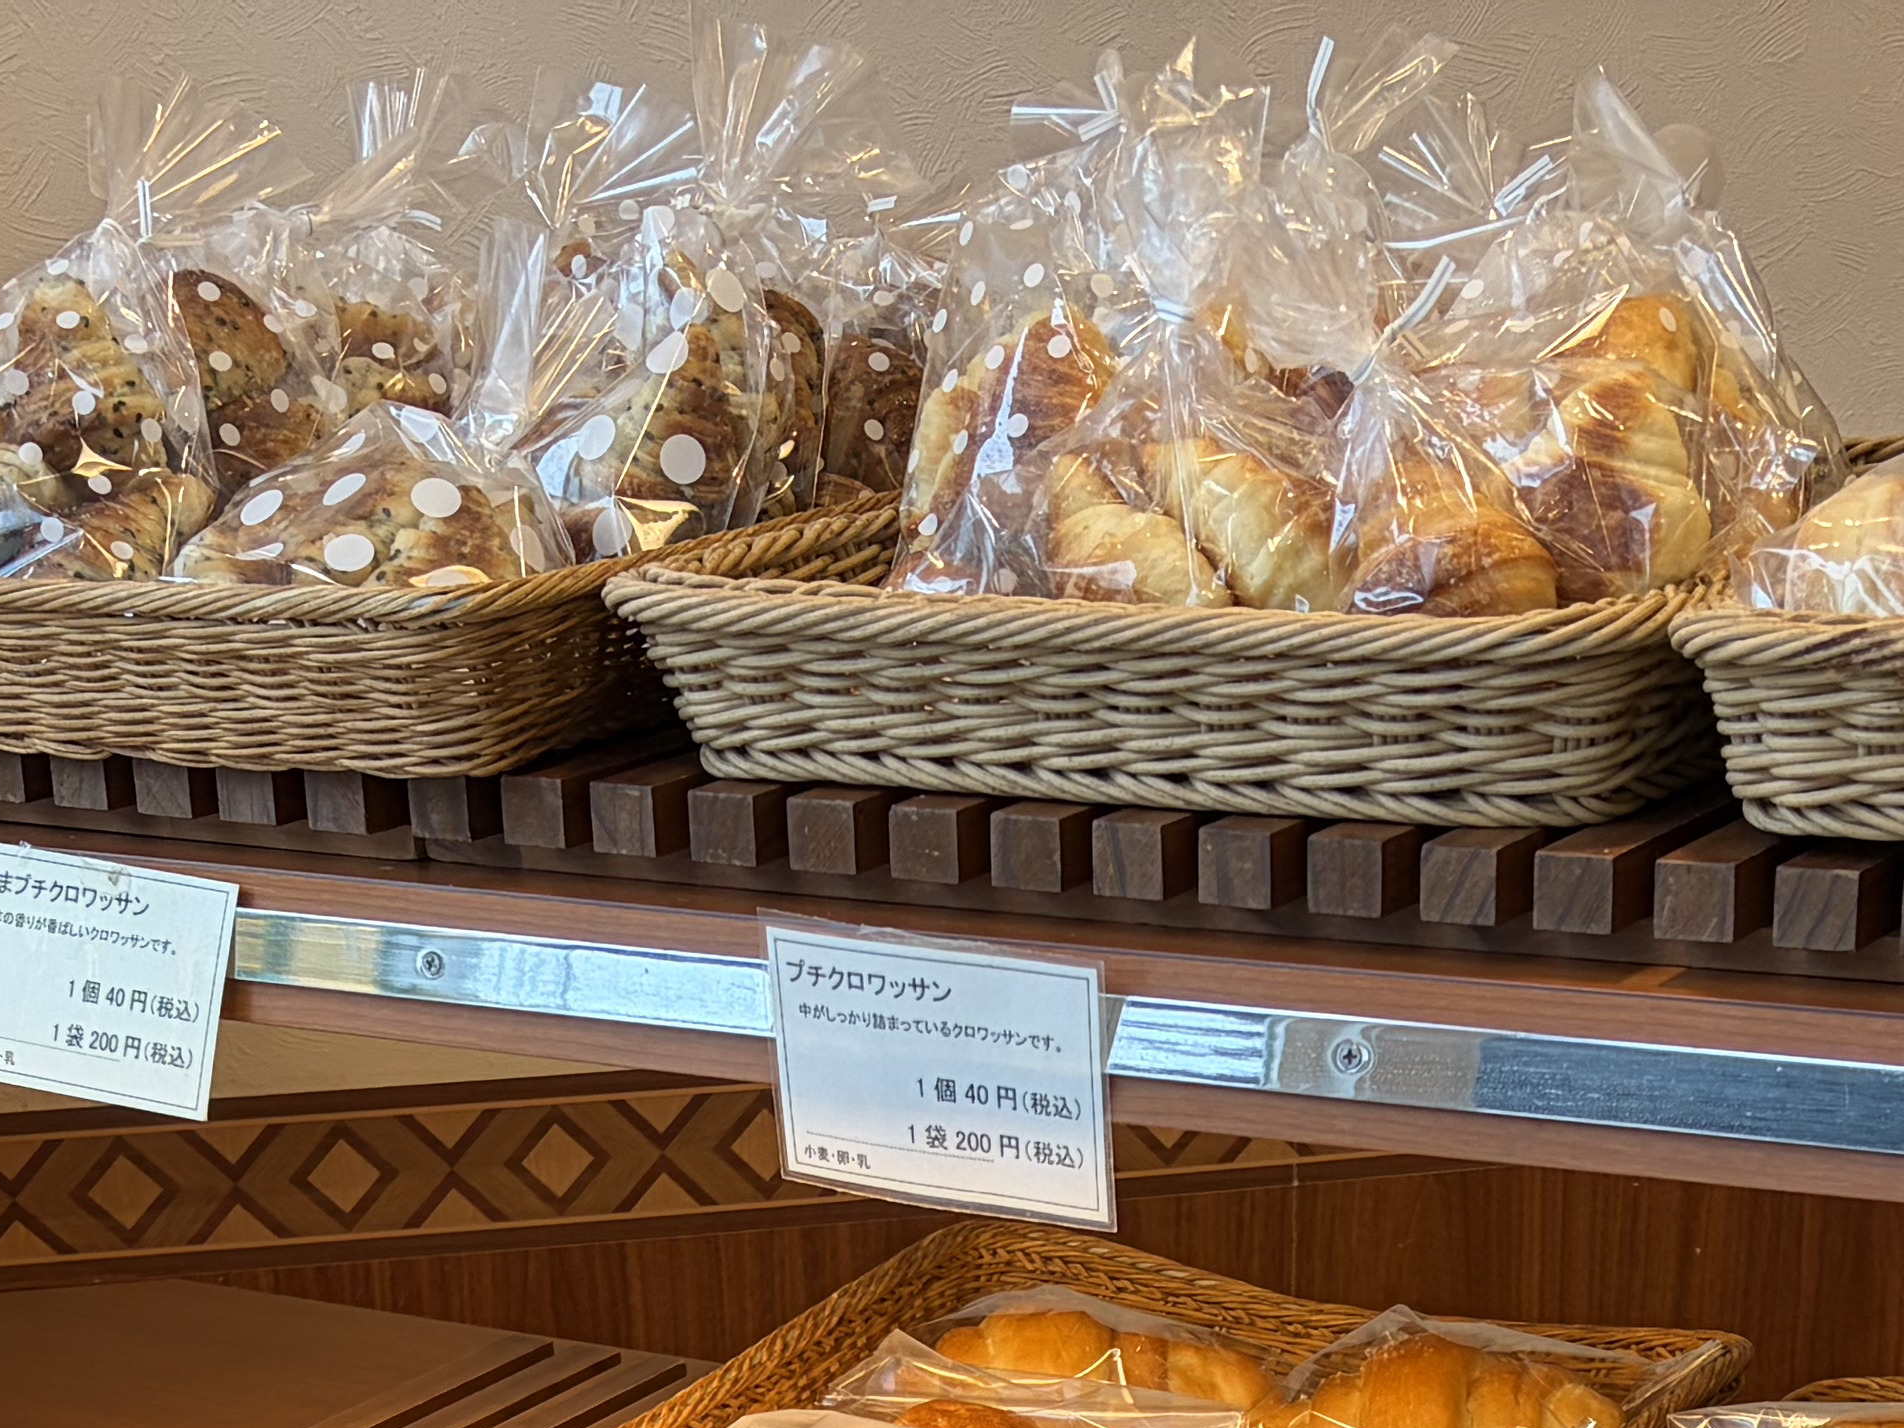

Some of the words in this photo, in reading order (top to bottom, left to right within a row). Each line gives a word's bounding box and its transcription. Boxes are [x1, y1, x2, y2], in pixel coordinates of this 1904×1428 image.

[785, 958, 952, 1003] プチクロワッサン
[798, 1003, 1062, 1054] 中がしっかり詰まっているクロワッサンです。
